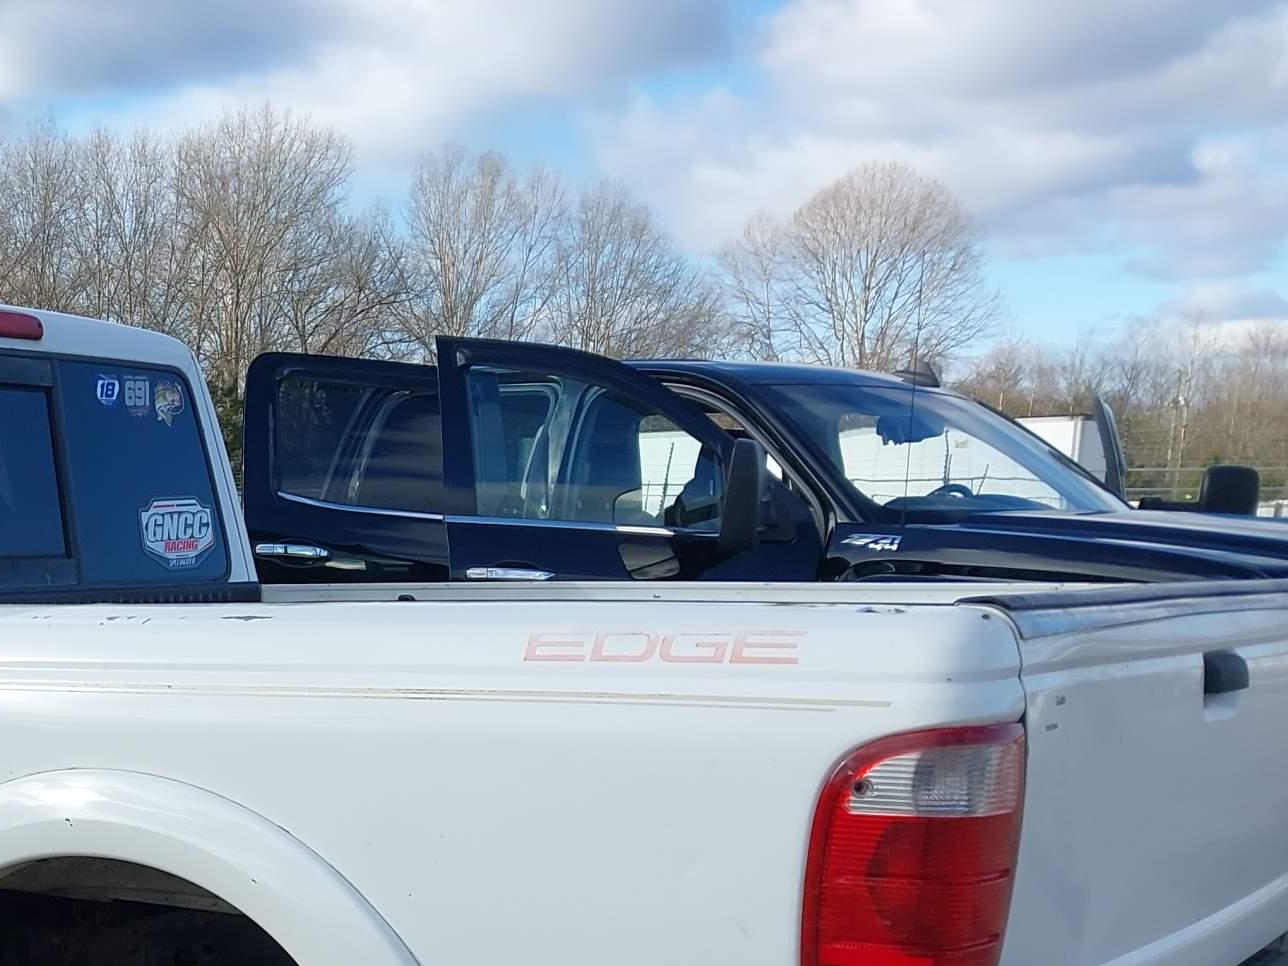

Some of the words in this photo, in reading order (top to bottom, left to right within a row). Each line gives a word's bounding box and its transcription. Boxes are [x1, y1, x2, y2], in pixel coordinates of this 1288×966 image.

[99, 381, 116, 399] 18
[125, 380, 150, 406] 691
[146, 510, 209, 543] GNCC
[164, 539, 200, 553] RACING
[523, 630, 808, 665] EDGE
